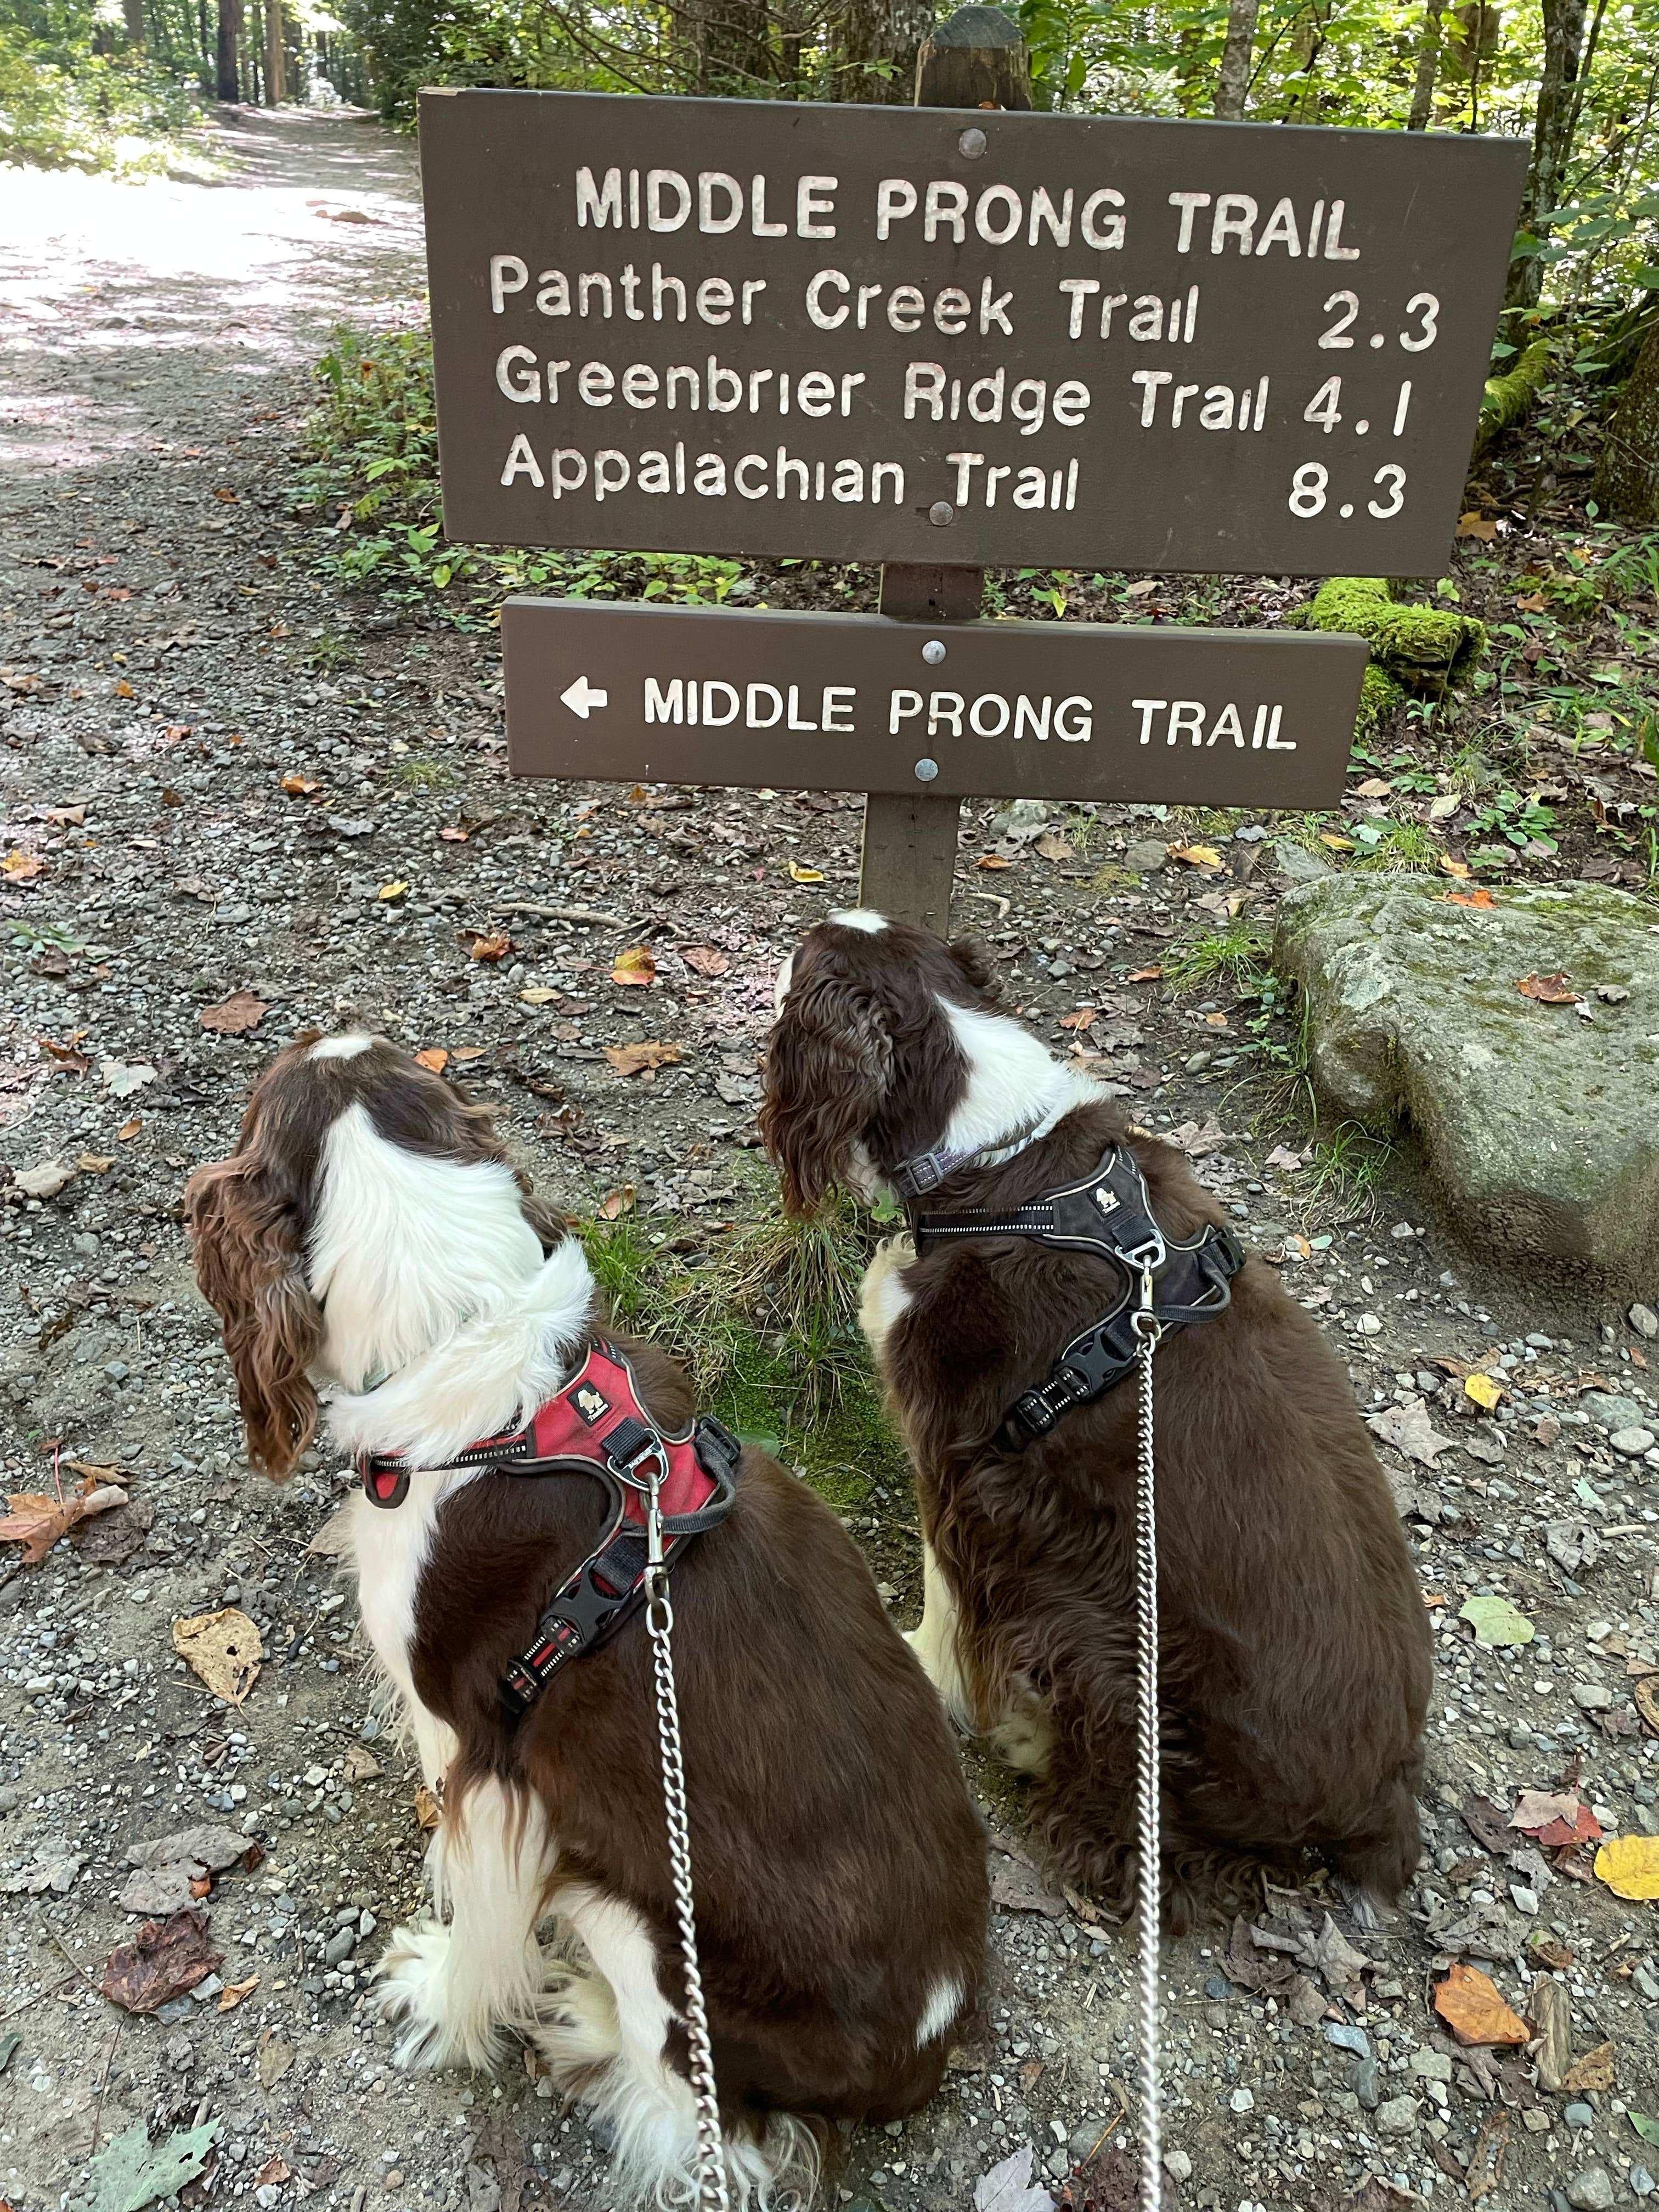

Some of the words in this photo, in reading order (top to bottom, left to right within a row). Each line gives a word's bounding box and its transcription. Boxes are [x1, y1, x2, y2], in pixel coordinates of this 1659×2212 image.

[576, 166, 838, 239] MIDDLE
[877, 179, 1126, 251] PRONG
[1168, 192, 1360, 260] TRAIL
[490, 255, 766, 325] Panther
[806, 269, 1013, 335] Creek
[1059, 279, 1199, 343] Trail
[1318, 290, 1440, 352] 2.3
[496, 345, 866, 417] Greenbrier
[904, 362, 1091, 436] Ridge
[1131, 370, 1269, 432] Trail
[1304, 376, 1412, 436] 4.1
[500, 433, 904, 505] Appalachian
[946, 453, 1079, 511] Trail
[1288, 462, 1406, 518] 8.3
[645, 677, 856, 732] MIDDLE
[889, 690, 1093, 742] PRONG
[1131, 699, 1297, 750] TRAIL
